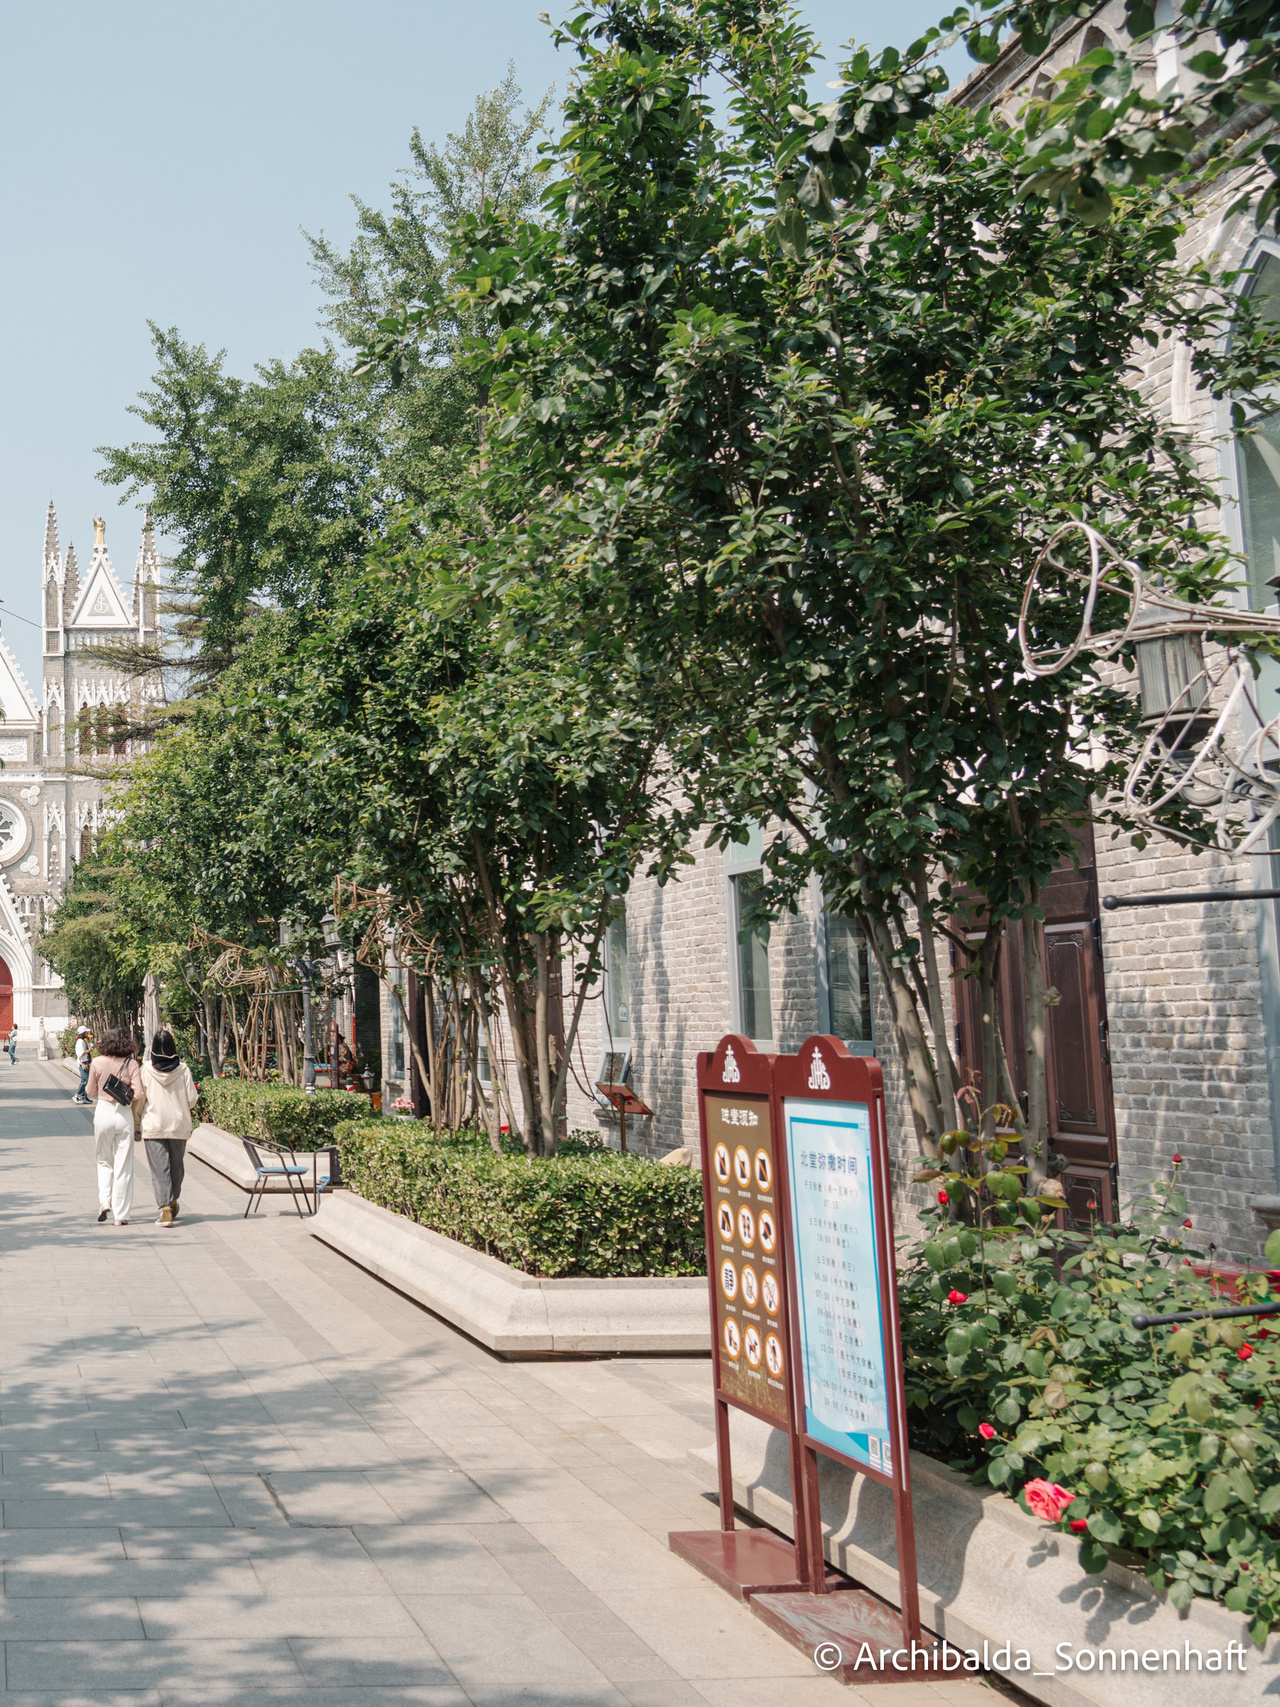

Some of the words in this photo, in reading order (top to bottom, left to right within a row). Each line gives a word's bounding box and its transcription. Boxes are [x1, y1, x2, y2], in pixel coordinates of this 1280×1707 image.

[721, 1108, 758, 1127] 进堂须知
[800, 1149, 858, 1175] 北堂弥撒时间
